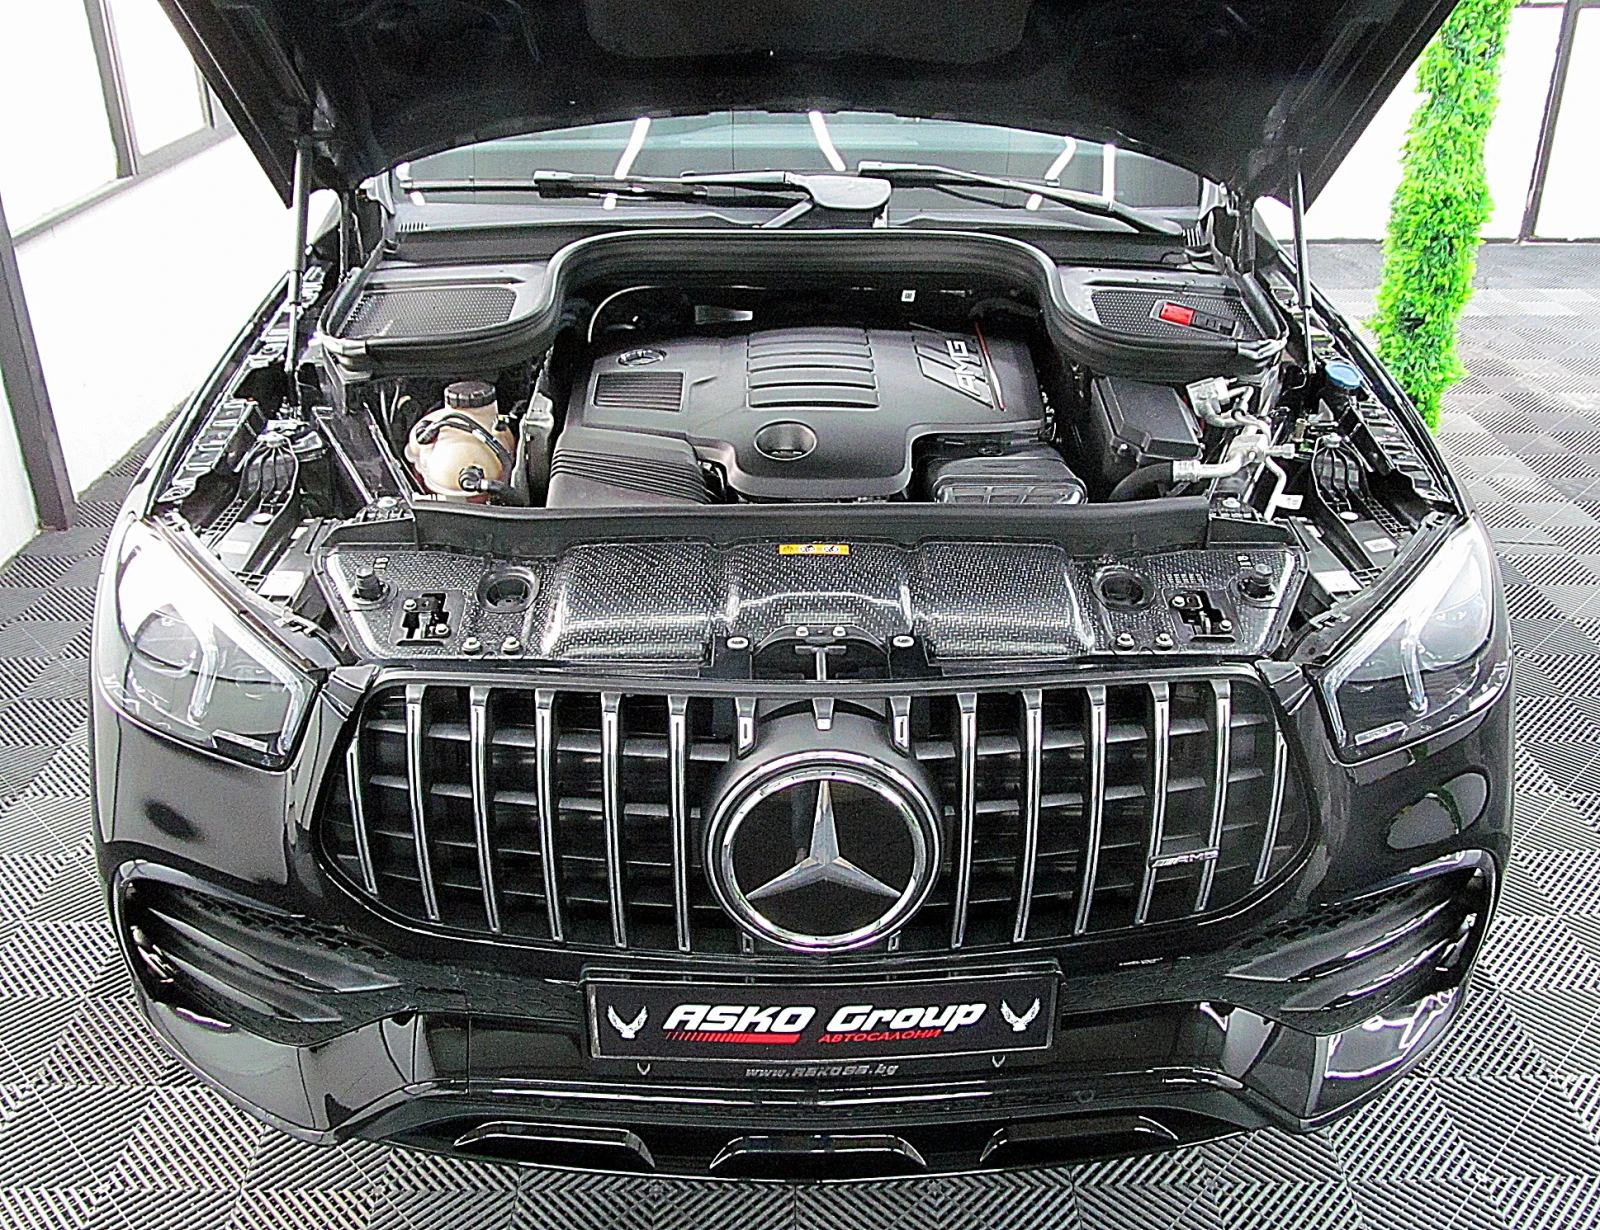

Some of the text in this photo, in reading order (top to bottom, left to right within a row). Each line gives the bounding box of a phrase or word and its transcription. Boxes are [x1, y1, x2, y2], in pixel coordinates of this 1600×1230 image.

[945, 339, 981, 397] AMG
[1172, 849, 1219, 865] AMG
[662, 1003, 987, 1033] ASKO Group
[818, 1028, 943, 1044] АВТОСАЛОНИ
